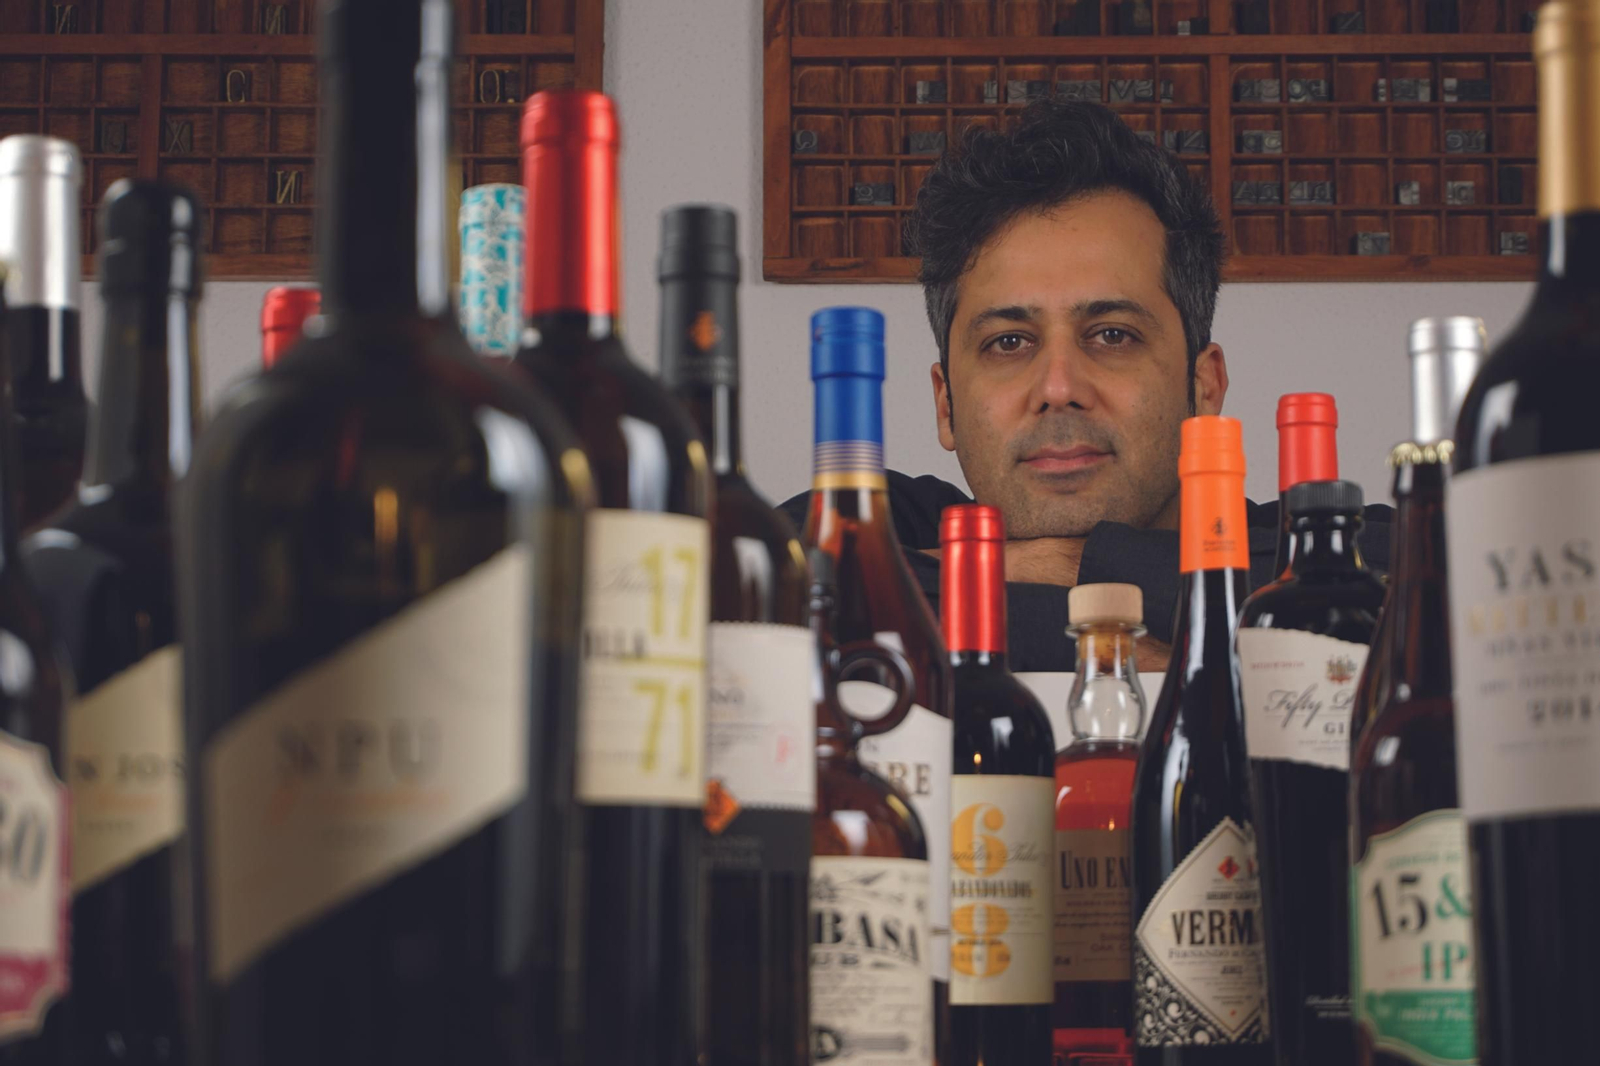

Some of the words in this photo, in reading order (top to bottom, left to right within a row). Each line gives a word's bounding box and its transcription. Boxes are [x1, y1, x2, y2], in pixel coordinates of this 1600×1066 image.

[1486, 541, 1597, 592] YAS
[641, 545, 698, 640] 17
[633, 681, 693, 777] 71
[1263, 682, 1322, 729] Fifty
[1527, 696, 1600, 728] 201
[951, 803, 1006, 878] 6
[1060, 850, 1098, 889] UNO
[951, 902, 1011, 978] 8
[1422, 942, 1475, 981] IP
